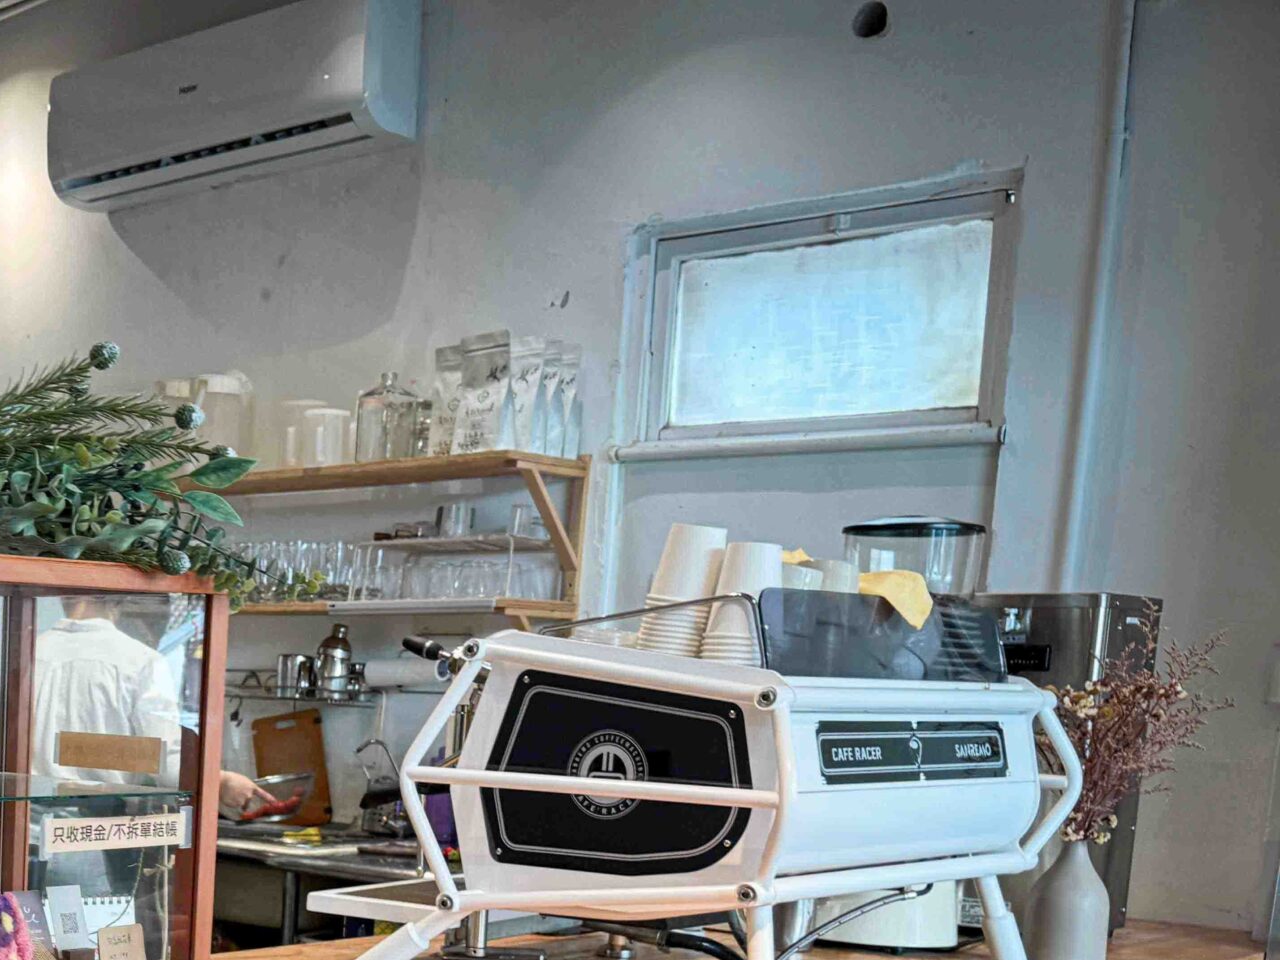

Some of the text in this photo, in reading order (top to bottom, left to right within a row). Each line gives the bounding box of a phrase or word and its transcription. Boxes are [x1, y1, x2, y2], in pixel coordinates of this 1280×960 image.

[832, 746, 883, 761] CAFE RACER
[955, 743, 992, 758] SANREMO
[52, 821, 178, 845] 只收現金/不拆單結帳
